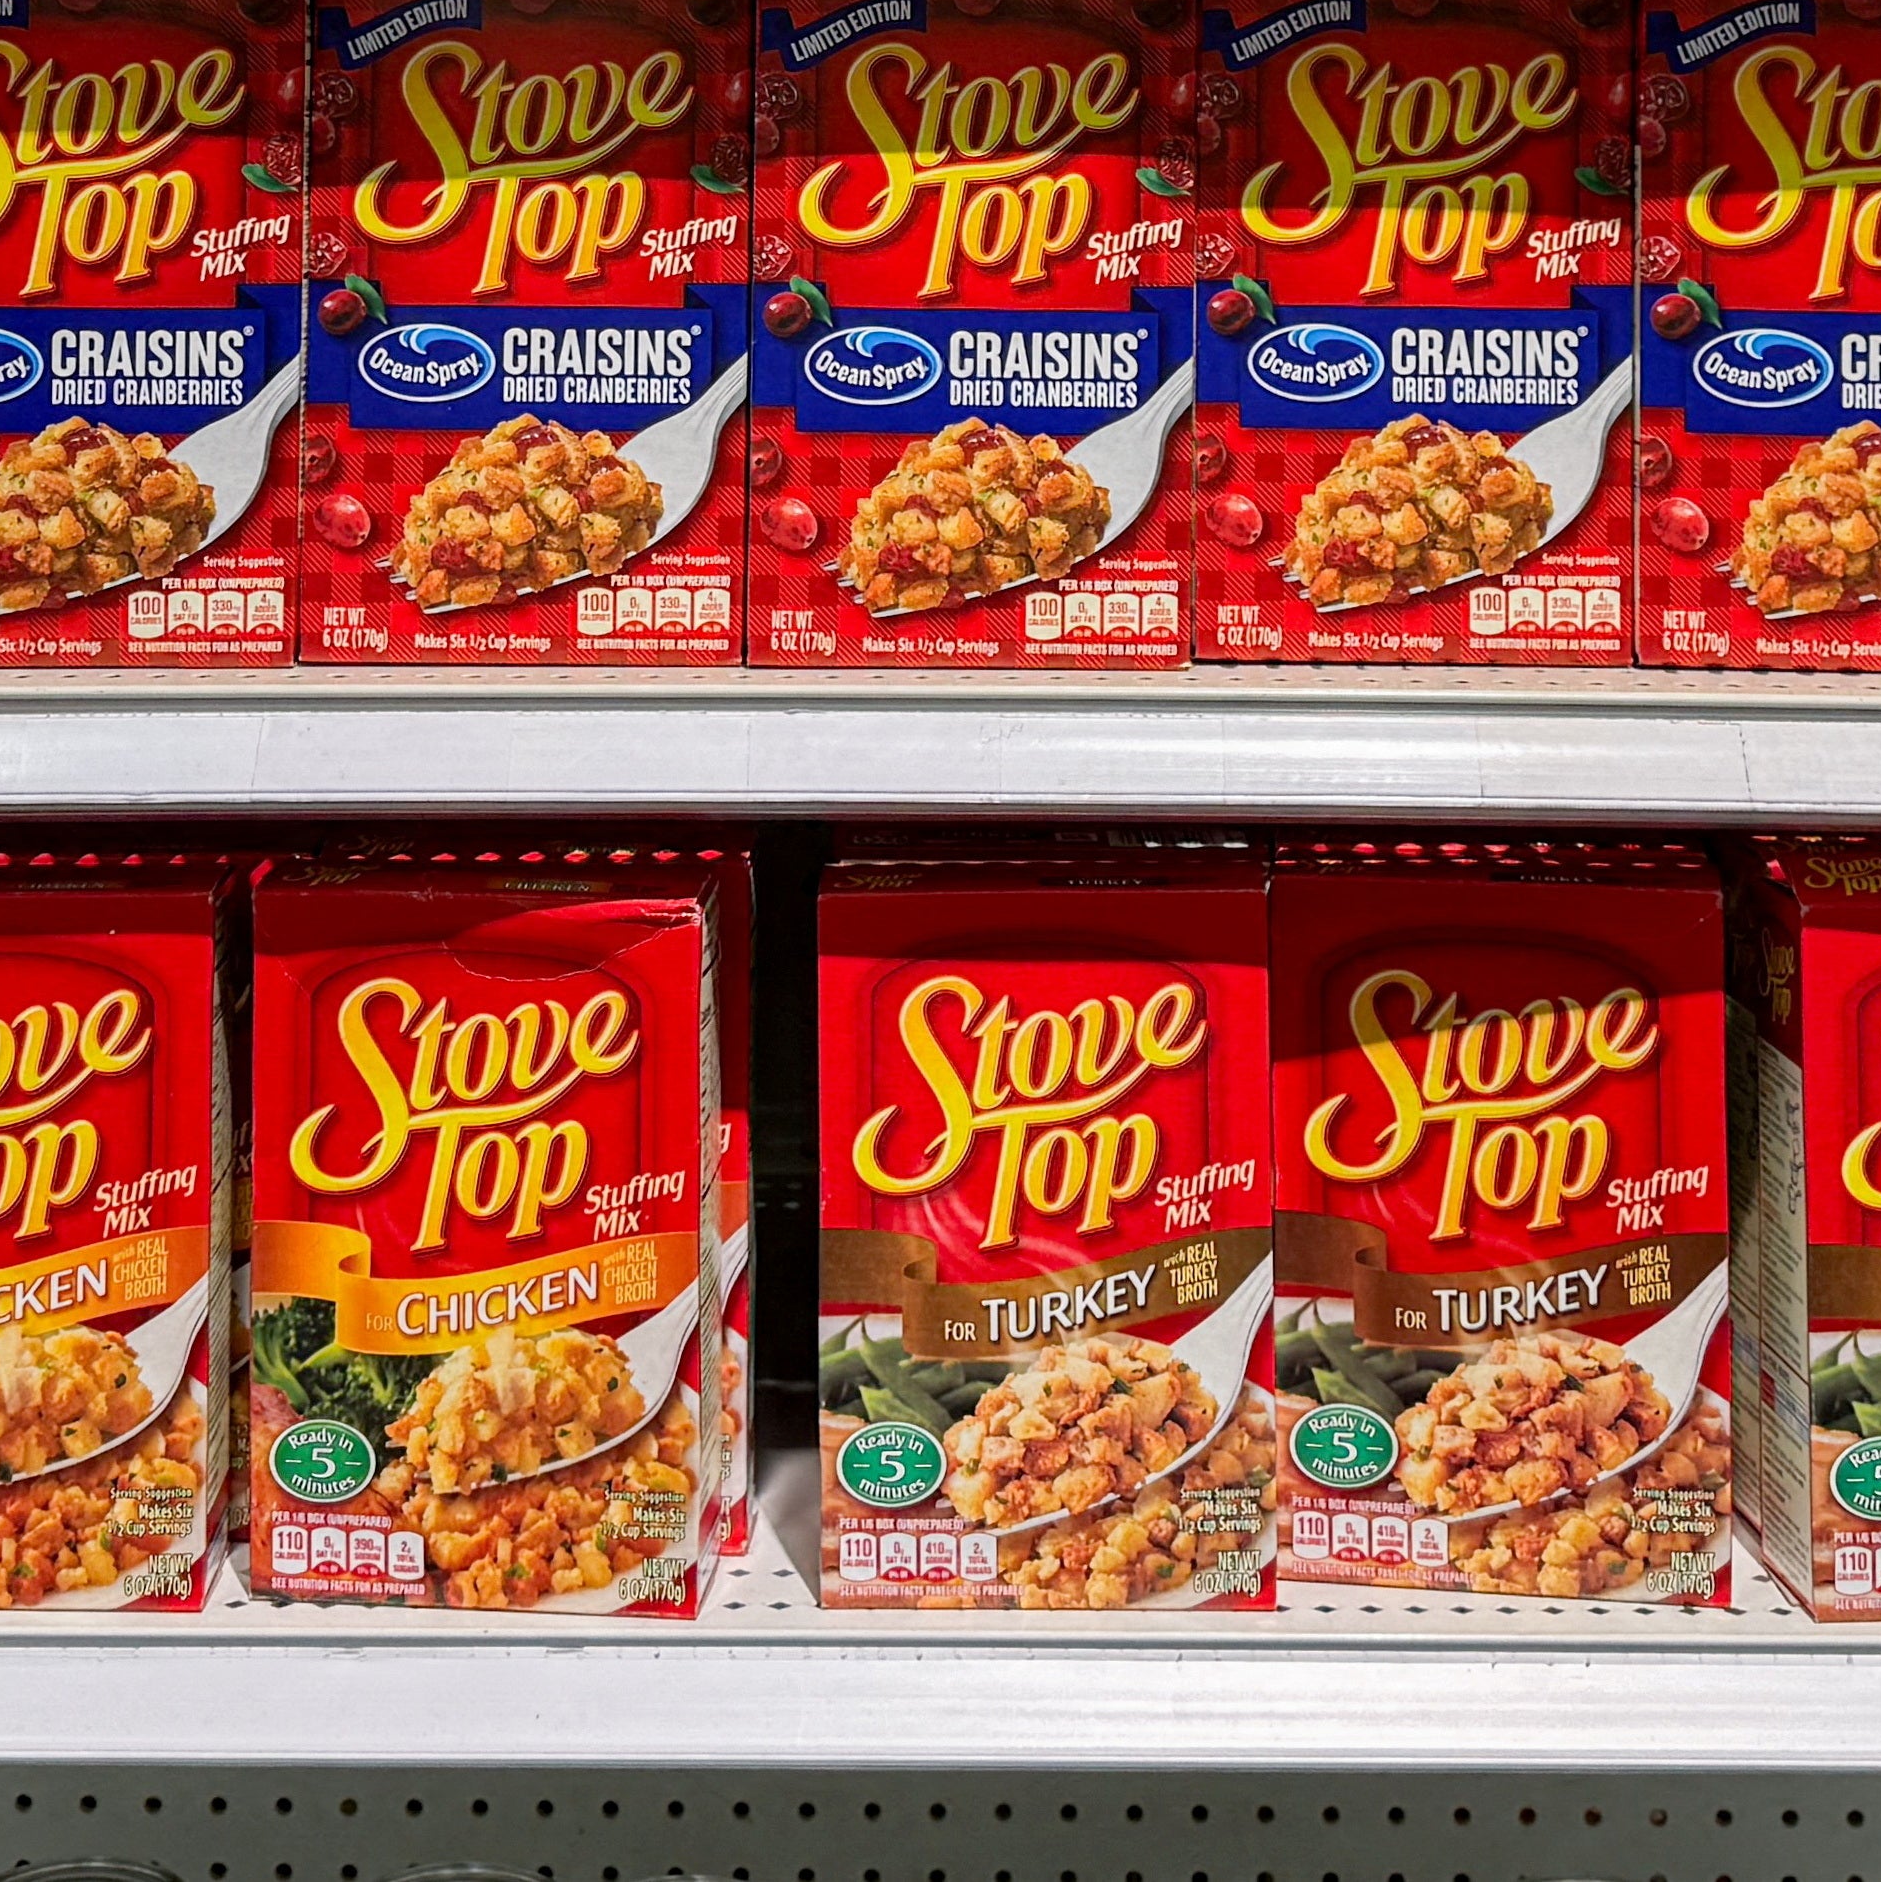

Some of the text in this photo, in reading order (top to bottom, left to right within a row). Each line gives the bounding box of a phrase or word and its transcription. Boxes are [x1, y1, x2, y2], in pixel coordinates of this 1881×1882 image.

[354, 40, 693, 244] Stove
[467, 169, 645, 297] Top
[503, 329, 691, 375] CRAISINS
[852, 975, 1208, 1197] Stove
[964, 1108, 1161, 1252] Top
[395, 1261, 598, 1338] CHICKEN
[944, 1262, 1157, 1344] FOR TURKEY
[1431, 1262, 1607, 1335] TURKEY
[854, 1430, 924, 1455] Ready in
[878, 1451, 906, 1482] 5
[859, 1478, 926, 1499] minutes
[1217, 1549, 1261, 1571] NET WT
